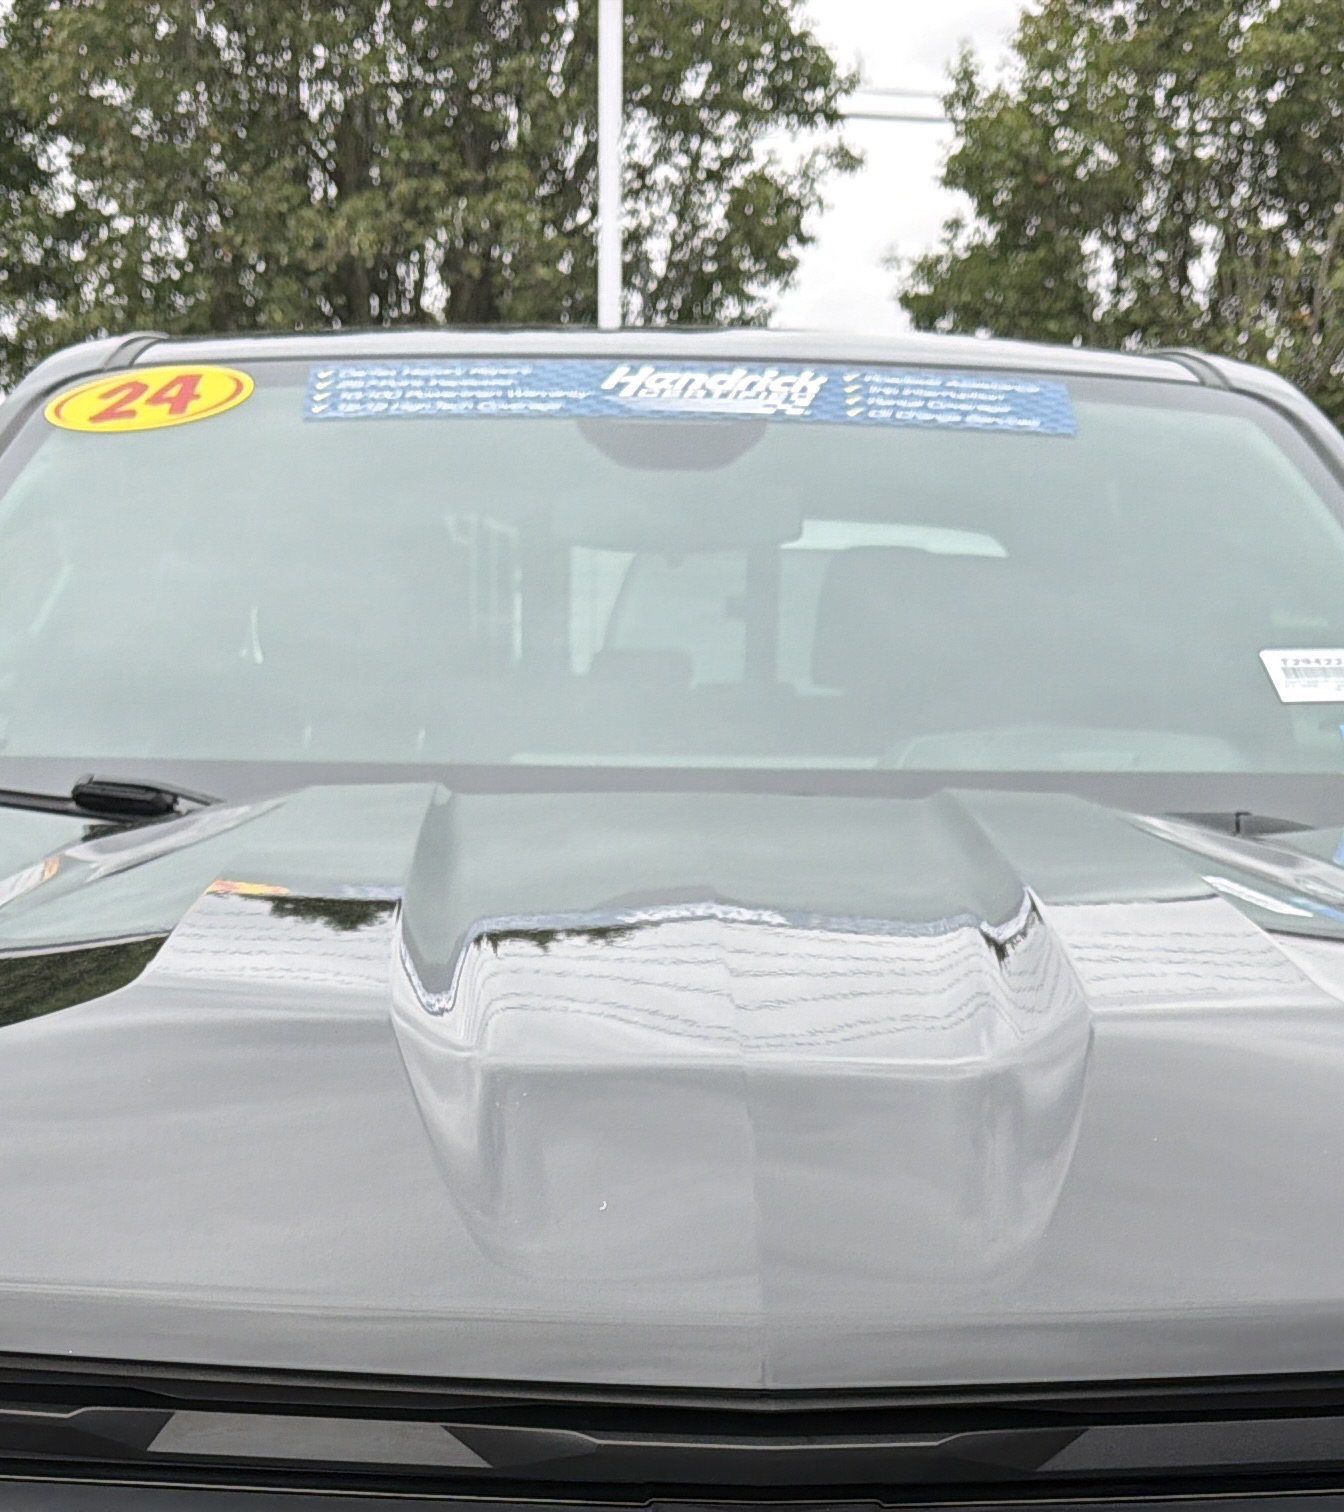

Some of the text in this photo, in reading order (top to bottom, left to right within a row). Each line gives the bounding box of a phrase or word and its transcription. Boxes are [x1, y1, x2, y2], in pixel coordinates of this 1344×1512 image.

[89, 374, 203, 422] 24
[507, 387, 595, 400] Warranty
[600, 363, 829, 398] Hendrick
